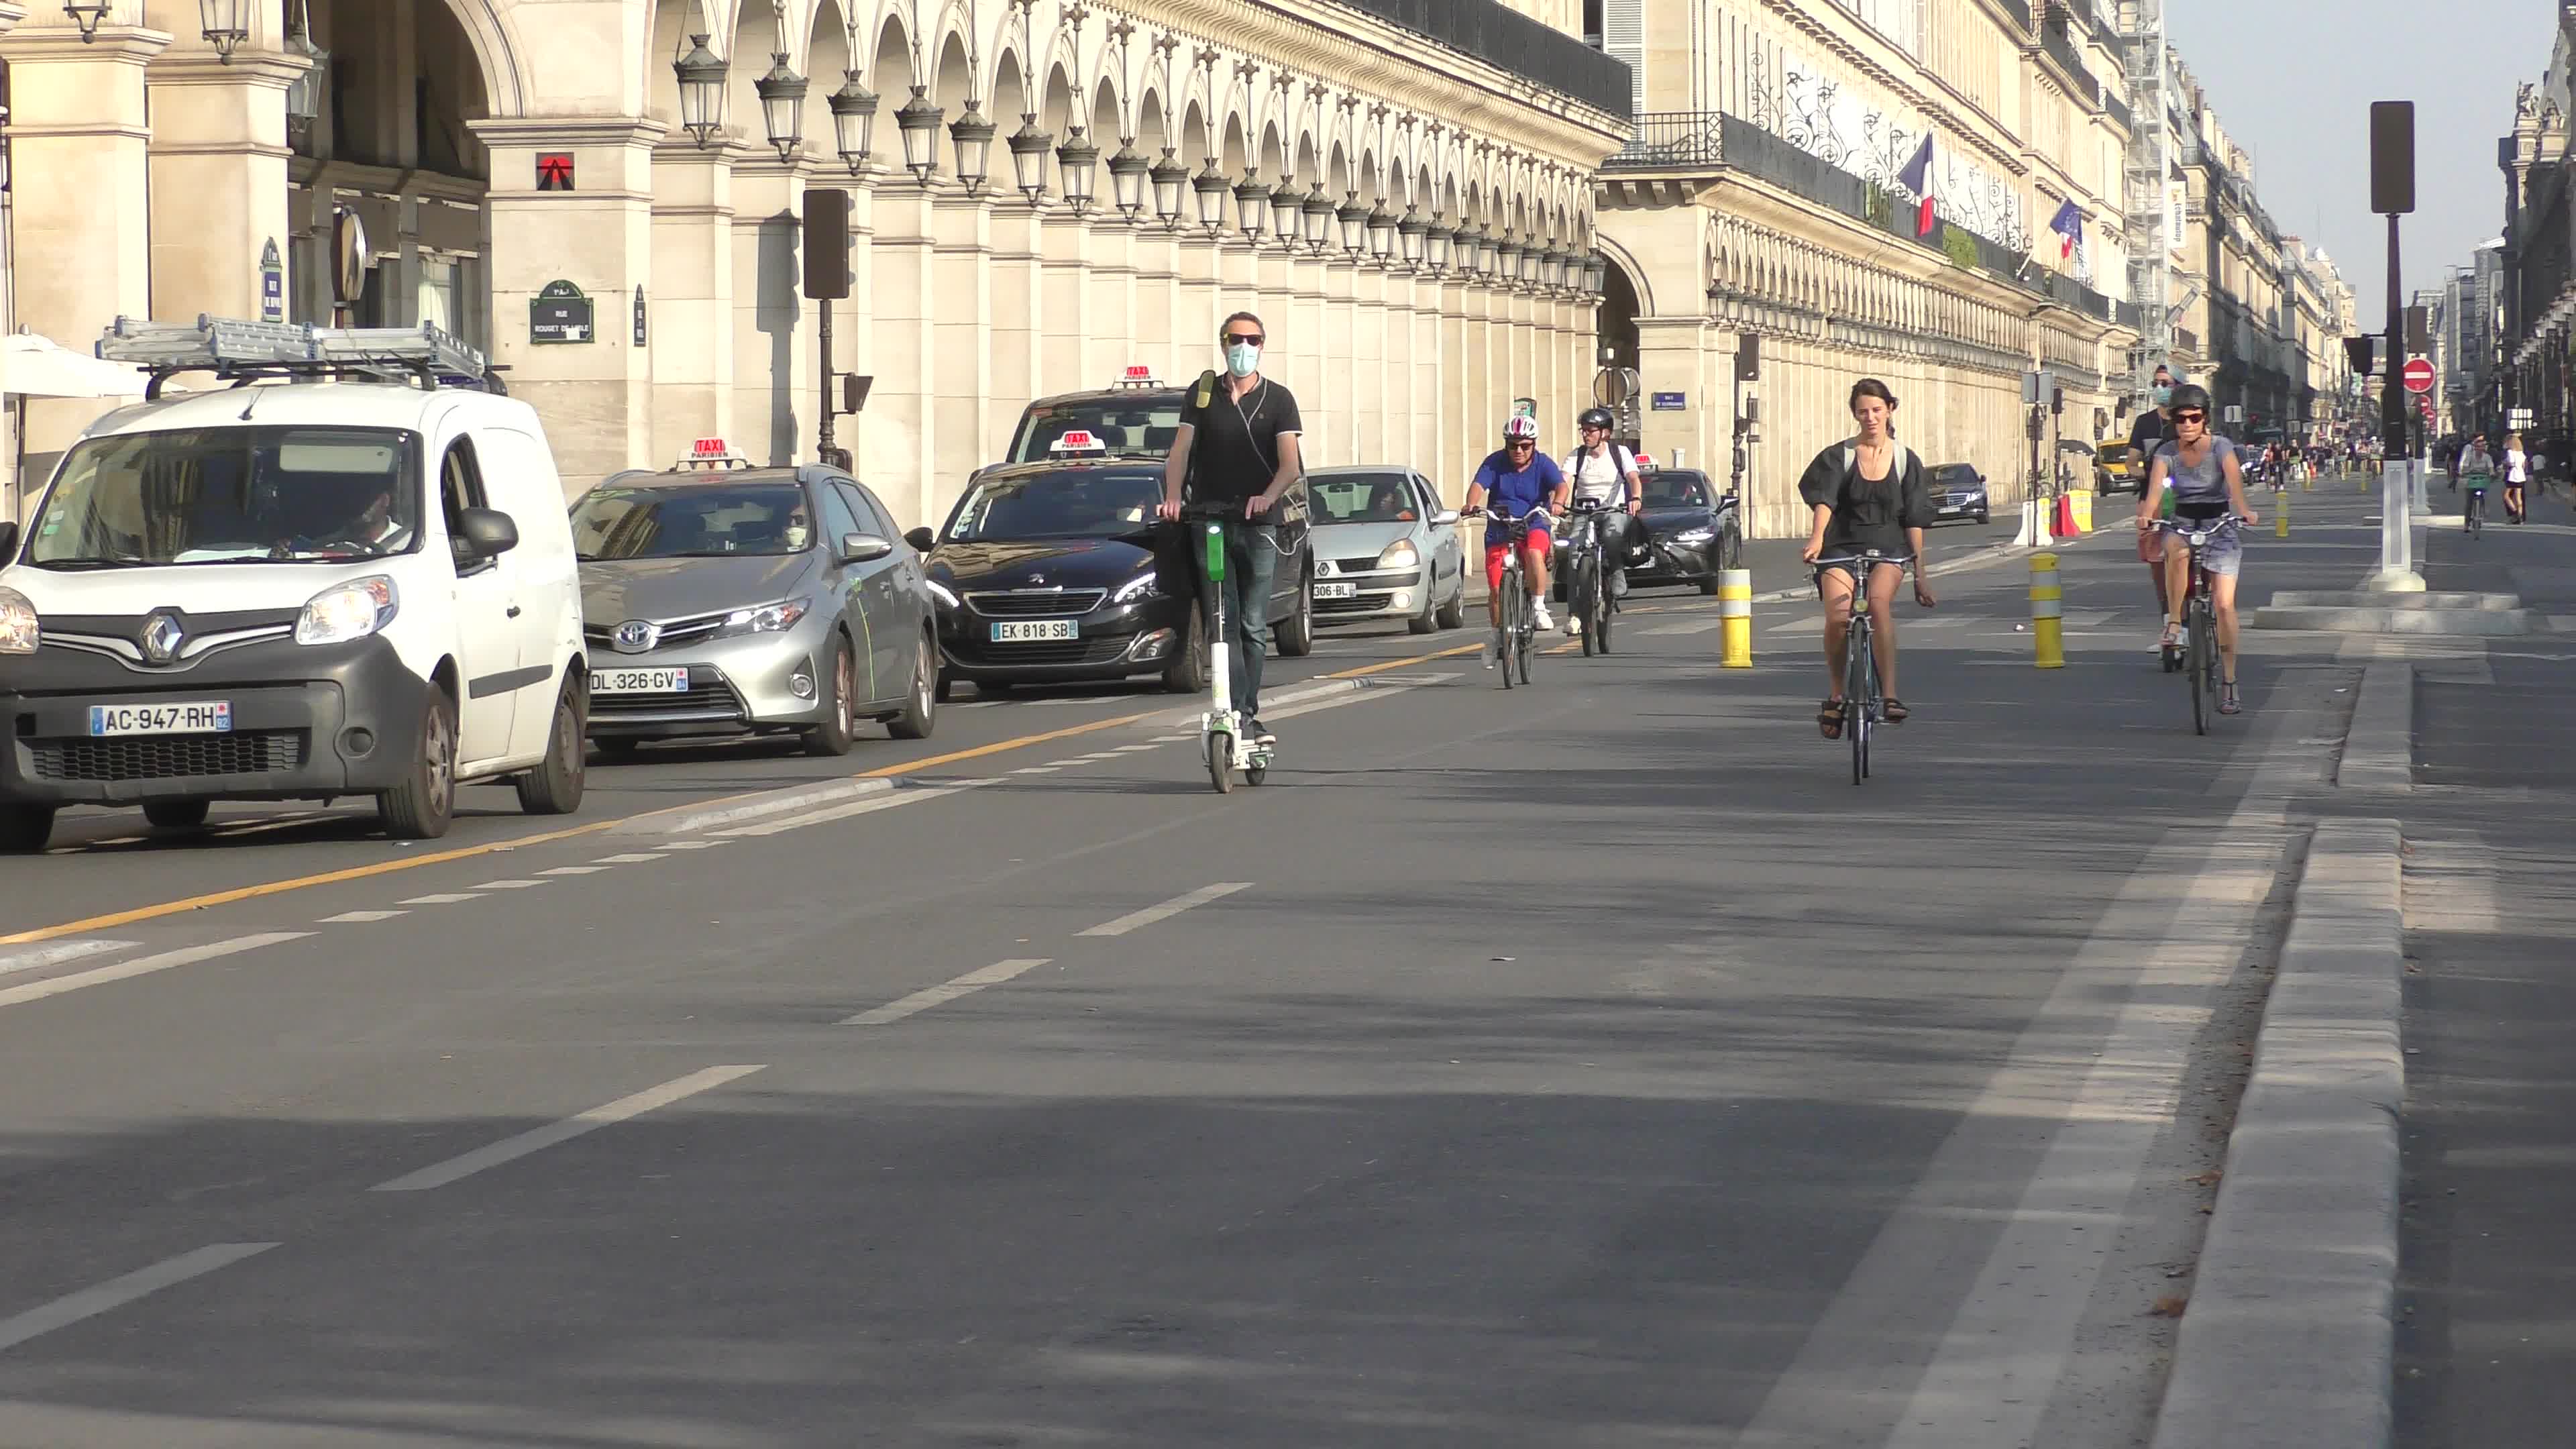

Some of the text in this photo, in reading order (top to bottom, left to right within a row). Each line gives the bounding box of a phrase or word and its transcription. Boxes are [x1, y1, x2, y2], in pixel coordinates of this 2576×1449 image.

[1128, 366, 1148, 374] TAXI
[1065, 433, 1088, 442] TAXI
[696, 439, 723, 451] TAXI
[1002, 623, 1068, 638] EK-818-SB
[591, 672, 675, 690] DL-326-GV
[106, 706, 214, 731] AC-947-RH
